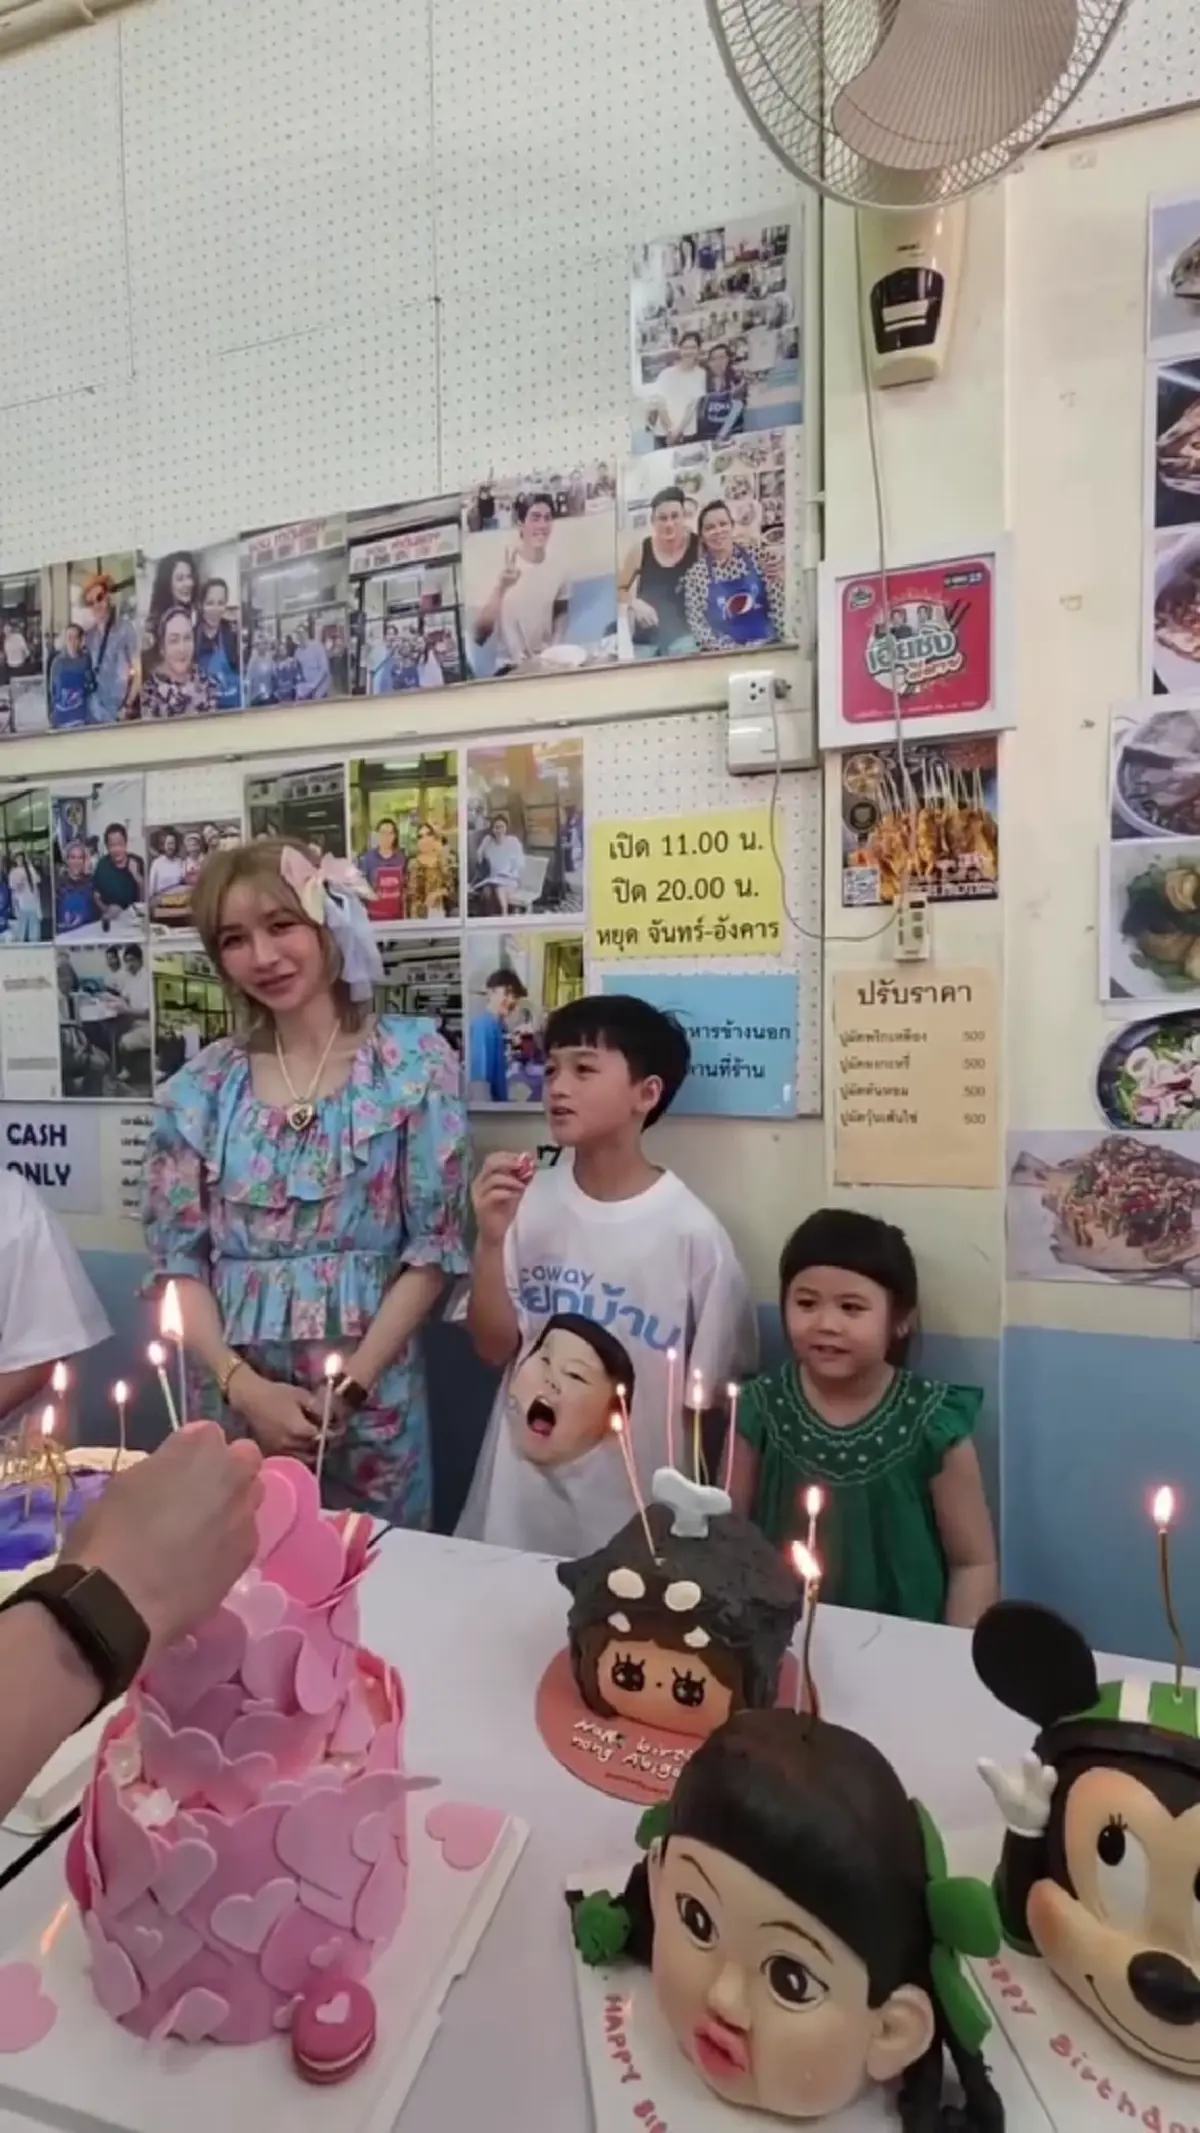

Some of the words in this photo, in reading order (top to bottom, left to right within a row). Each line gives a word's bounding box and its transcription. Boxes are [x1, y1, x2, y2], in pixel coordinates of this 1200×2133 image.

[609, 831, 650, 860] เปิด
[661, 830, 729, 857] 11.00
[738, 831, 764, 851] น.
[611, 876, 647, 904] ปิด
[656, 876, 725, 902] 20.00
[733, 878, 759, 898] น.
[596, 926, 638, 952] หยุด
[647, 914, 780, 944] จันทร์-อังคาร
[857, 978, 973, 1005] ปรับราคา
[687, 1018, 791, 1040] หารข้างนอก
[962, 1030, 986, 1042] 500
[963, 1057, 986, 1070] 500
[963, 1085, 986, 1097] 500
[963, 1113, 986, 1126] 500
[6, 1123, 68, 1147] CASH
[604, 1993, 642, 2084] HAPPY
[1049, 2033, 1200, 2133] Birthda
